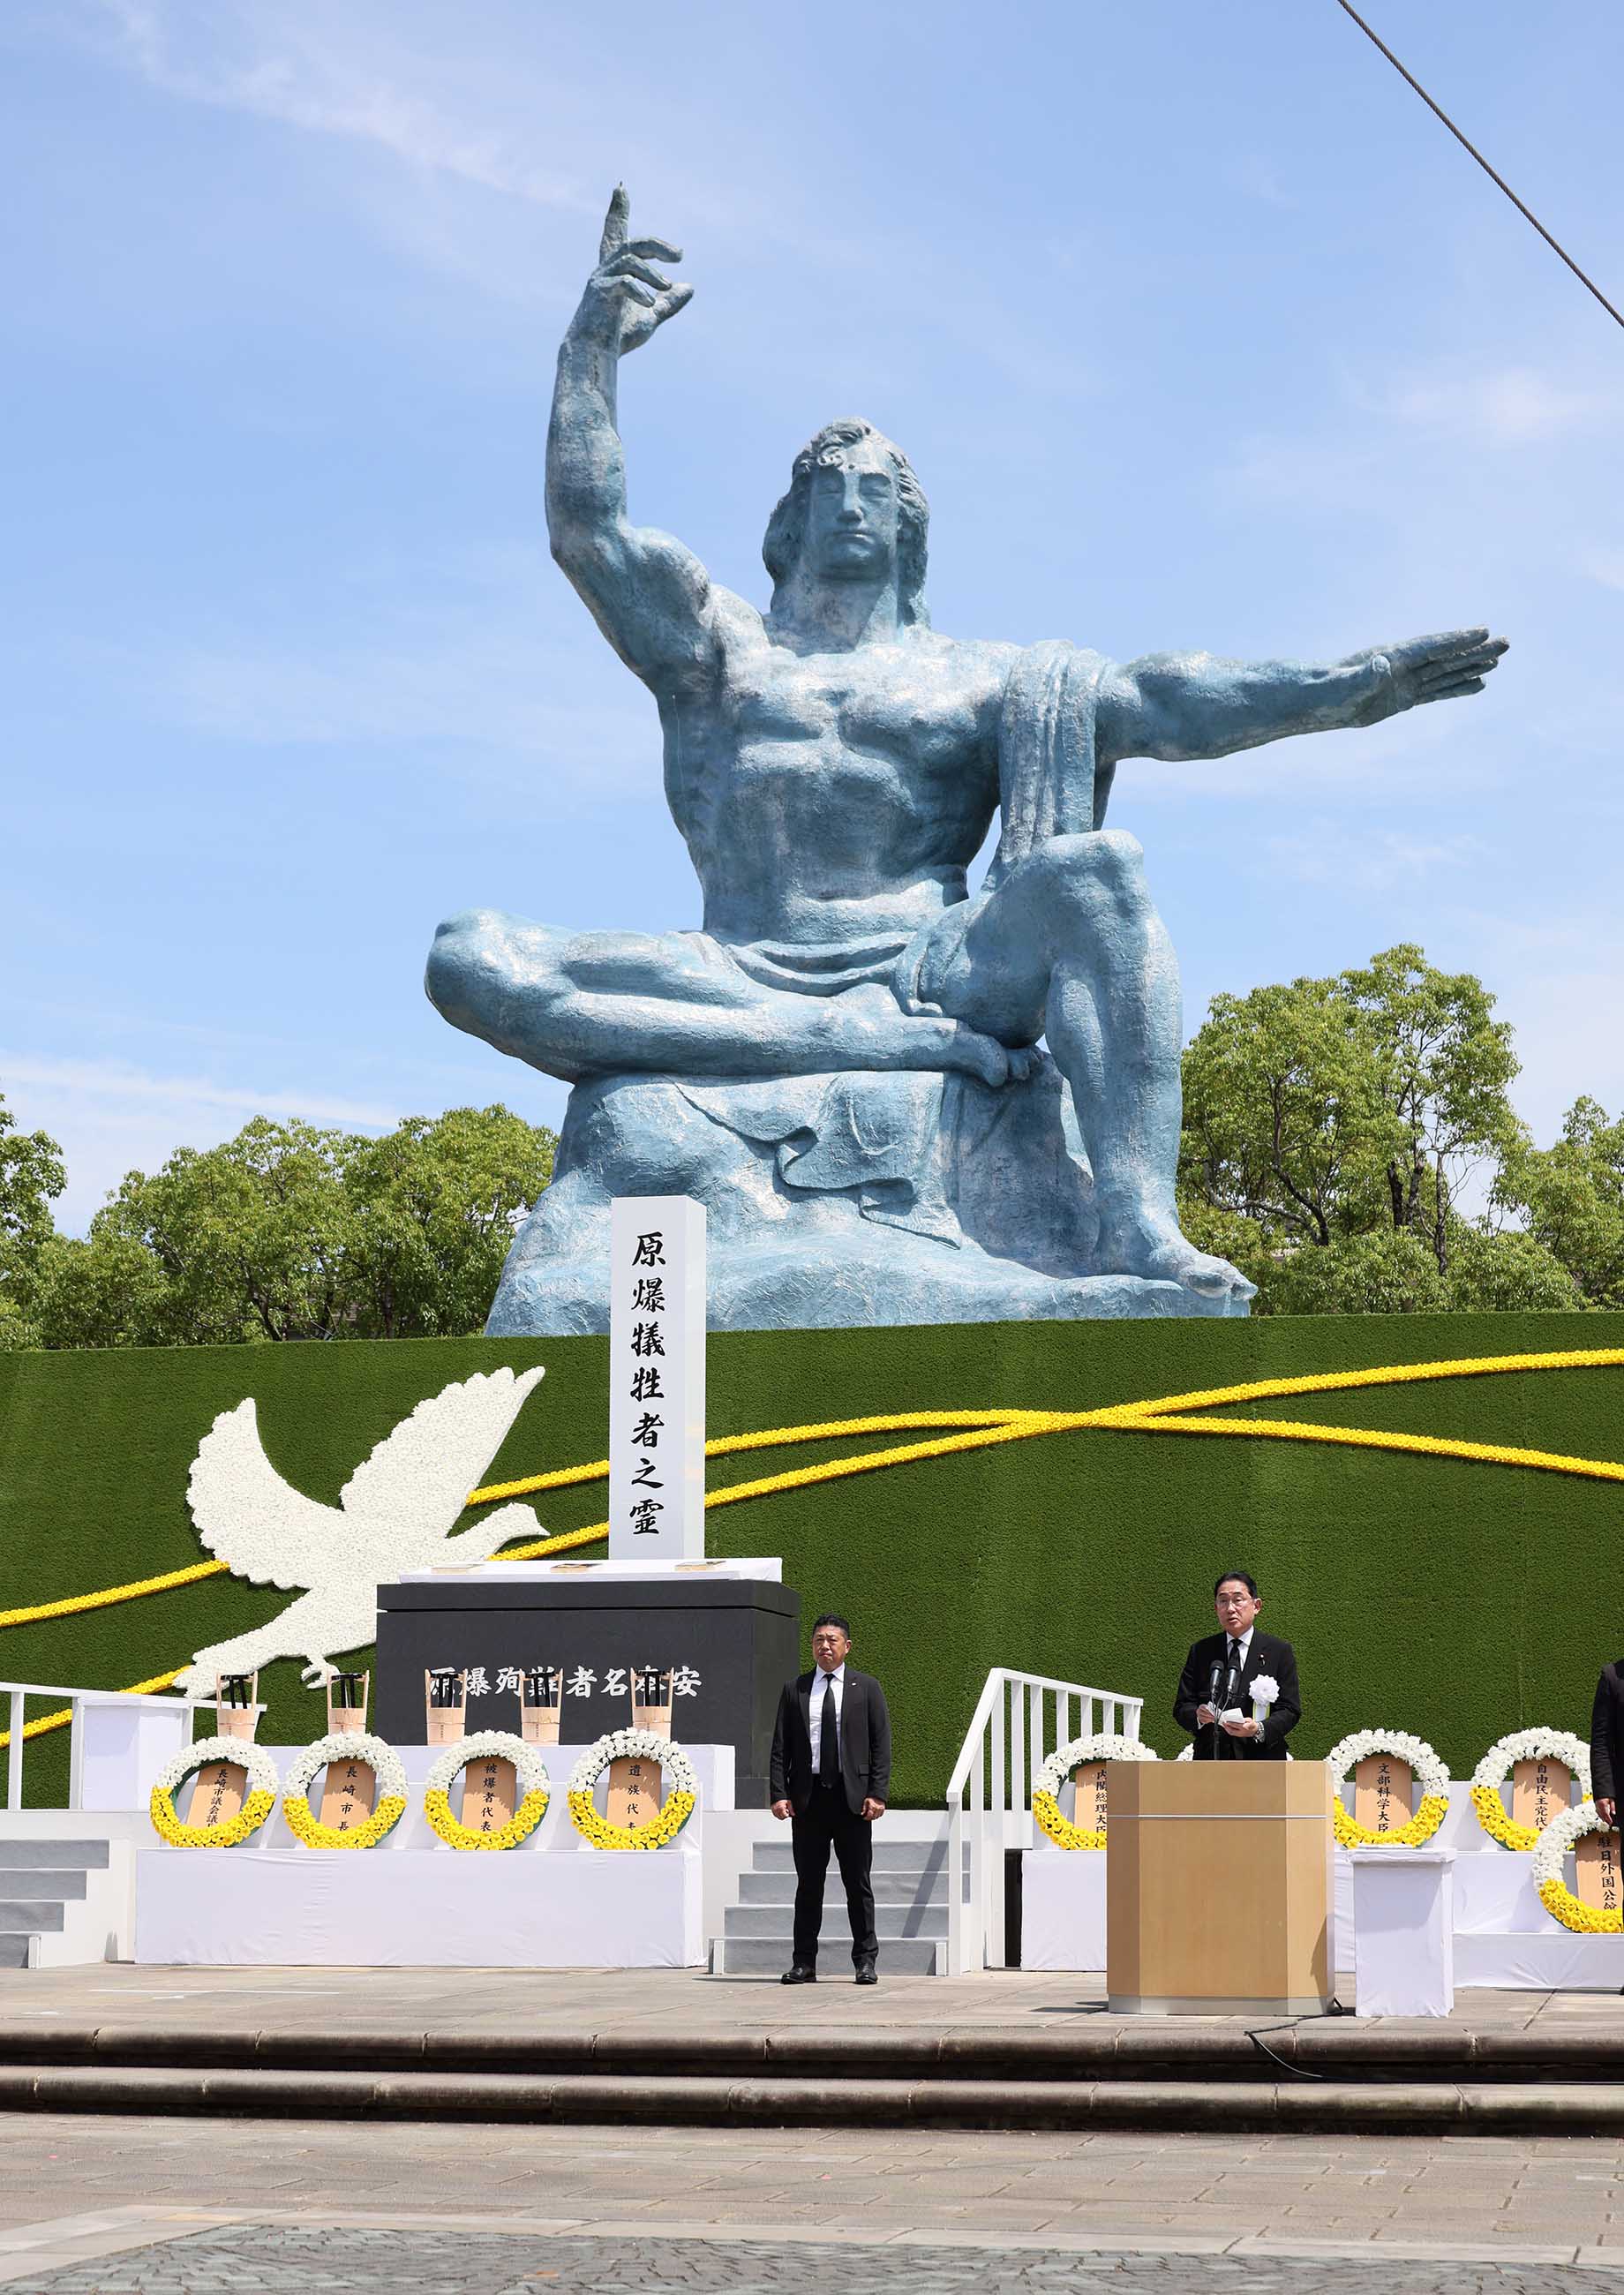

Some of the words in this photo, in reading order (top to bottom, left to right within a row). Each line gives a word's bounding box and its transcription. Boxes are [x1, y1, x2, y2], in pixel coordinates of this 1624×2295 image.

[337, 1766, 357, 1832] 長崎市長
[480, 1763, 498, 1832] 被爆者代表
[1377, 1763, 1391, 1832] 文部科学大臣
[1534, 1764, 1549, 1832] 自由民主党代
